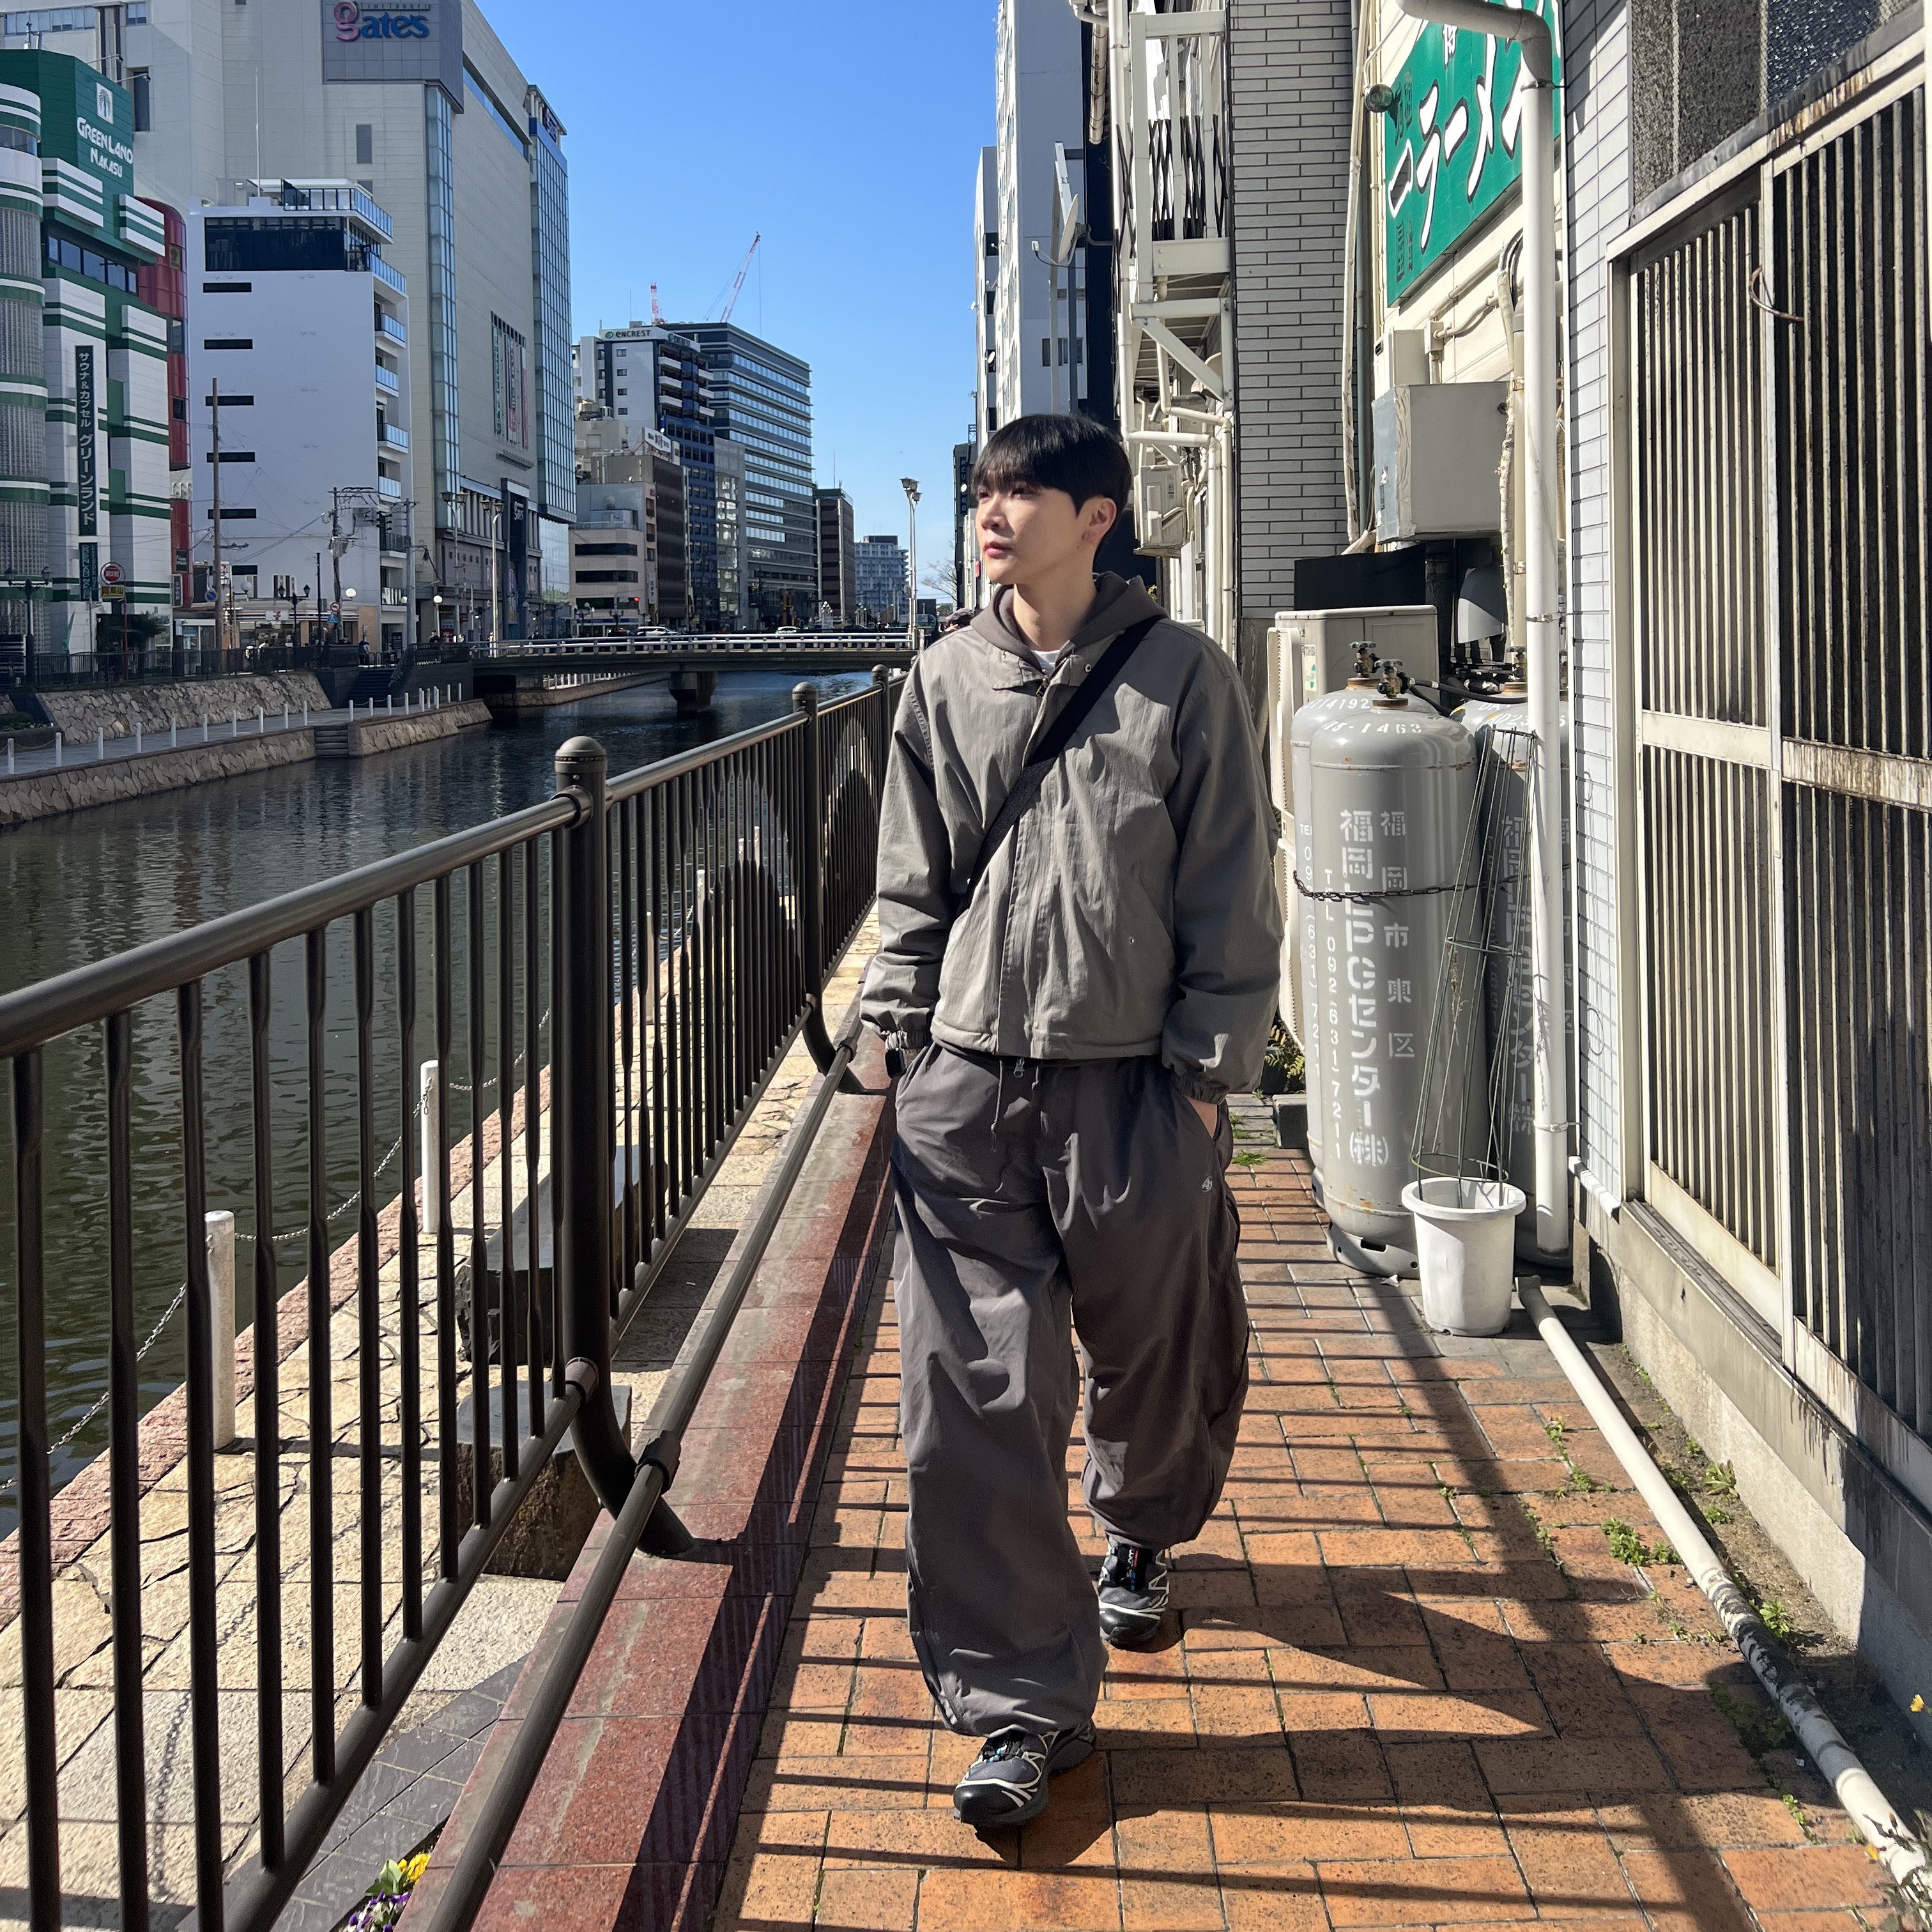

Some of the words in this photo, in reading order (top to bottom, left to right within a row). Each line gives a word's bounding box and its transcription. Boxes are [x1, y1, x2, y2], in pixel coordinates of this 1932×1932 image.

[90, 147, 123, 178] NAKASU
[79, 434, 95, 526] グリーンランド
